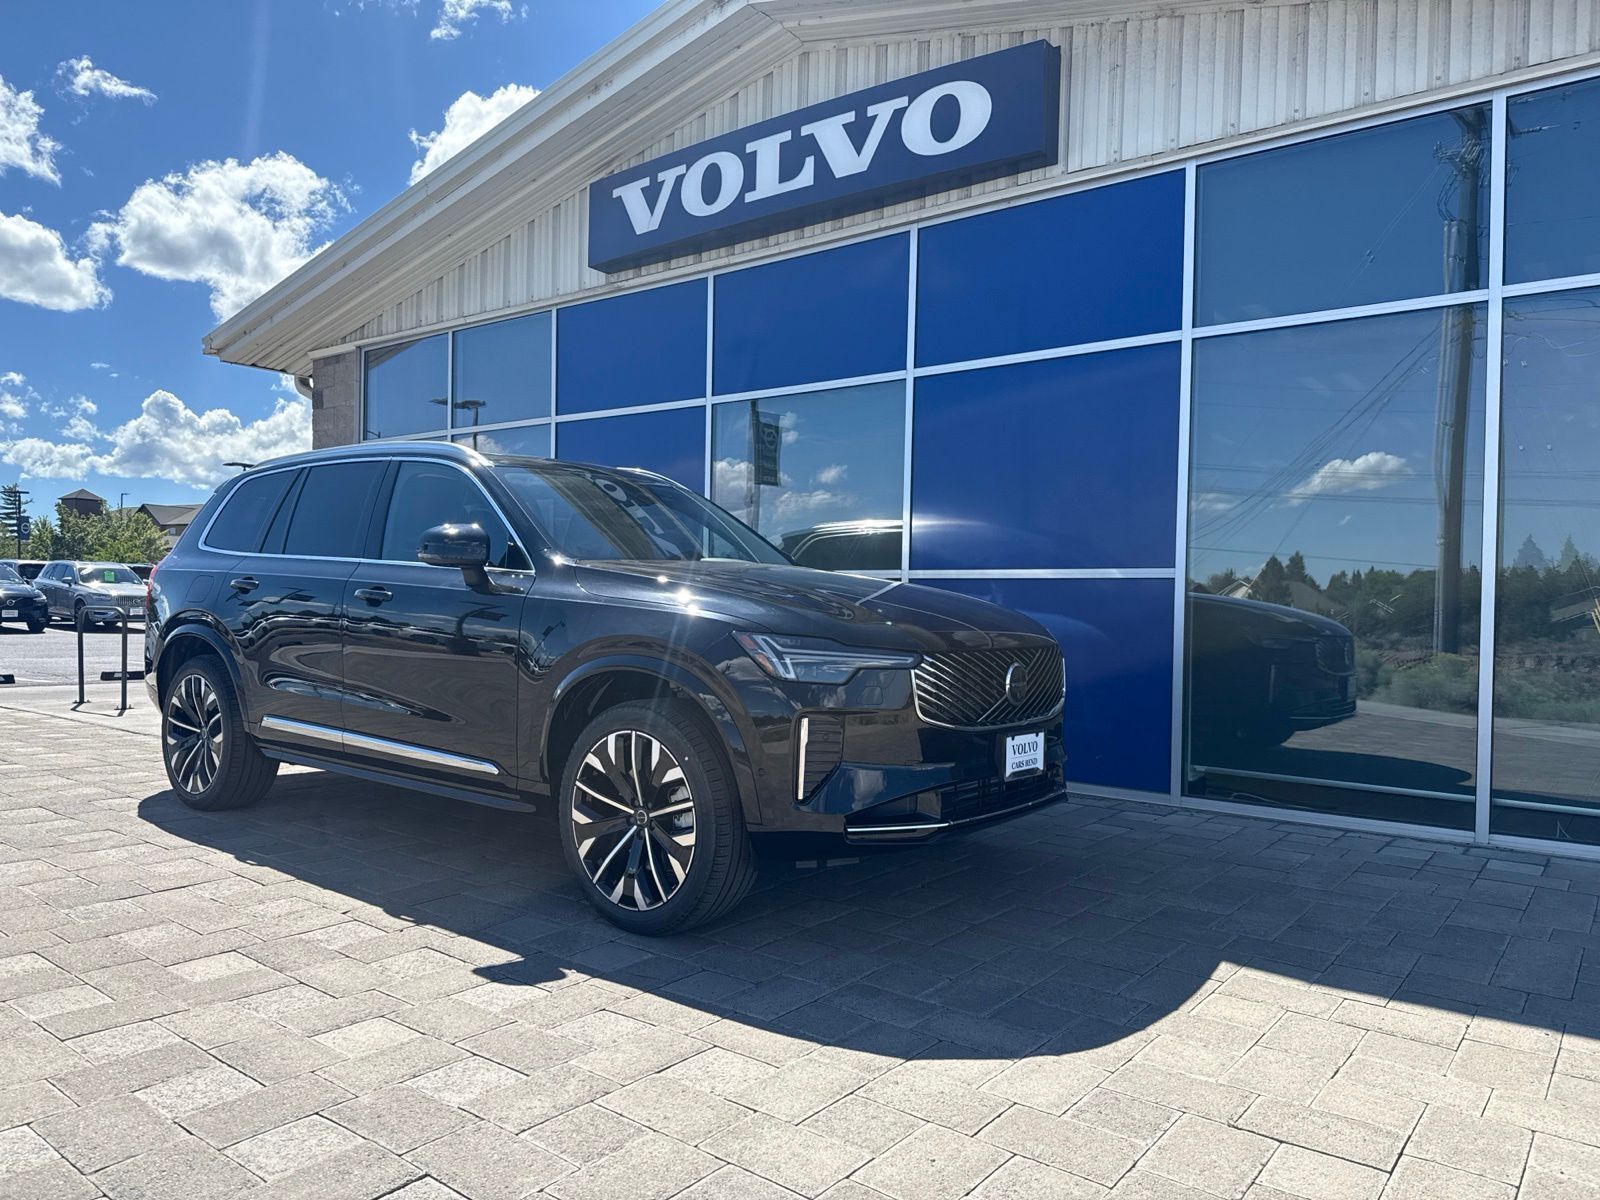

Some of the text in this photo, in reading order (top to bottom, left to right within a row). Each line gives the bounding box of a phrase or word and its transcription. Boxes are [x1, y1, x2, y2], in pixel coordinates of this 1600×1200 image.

[612, 80, 993, 235] VOLVO
[1012, 741, 1038, 755] VOLVO
[1011, 760, 1025, 770] CARS
